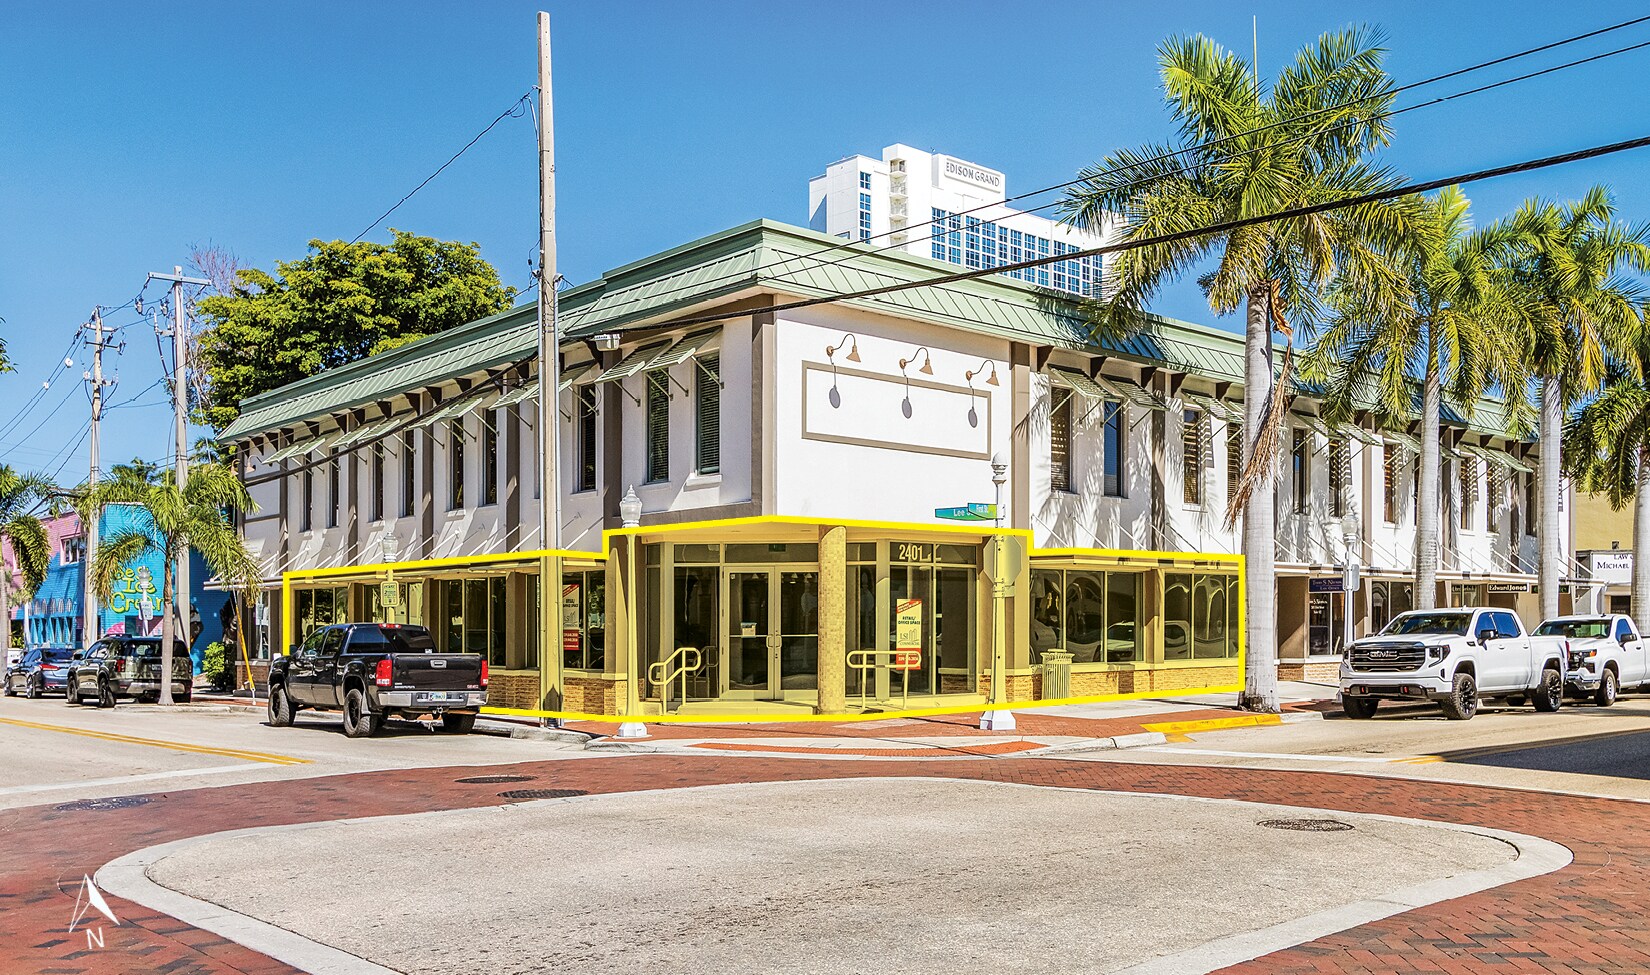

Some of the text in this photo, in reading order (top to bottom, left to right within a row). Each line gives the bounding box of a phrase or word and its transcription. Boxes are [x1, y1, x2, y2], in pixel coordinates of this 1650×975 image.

[946, 162, 1000, 187] EDISON GRAND
[953, 508, 965, 516] Lee
[899, 544, 923, 560] 2401
[1369, 650, 1398, 658] GMC
